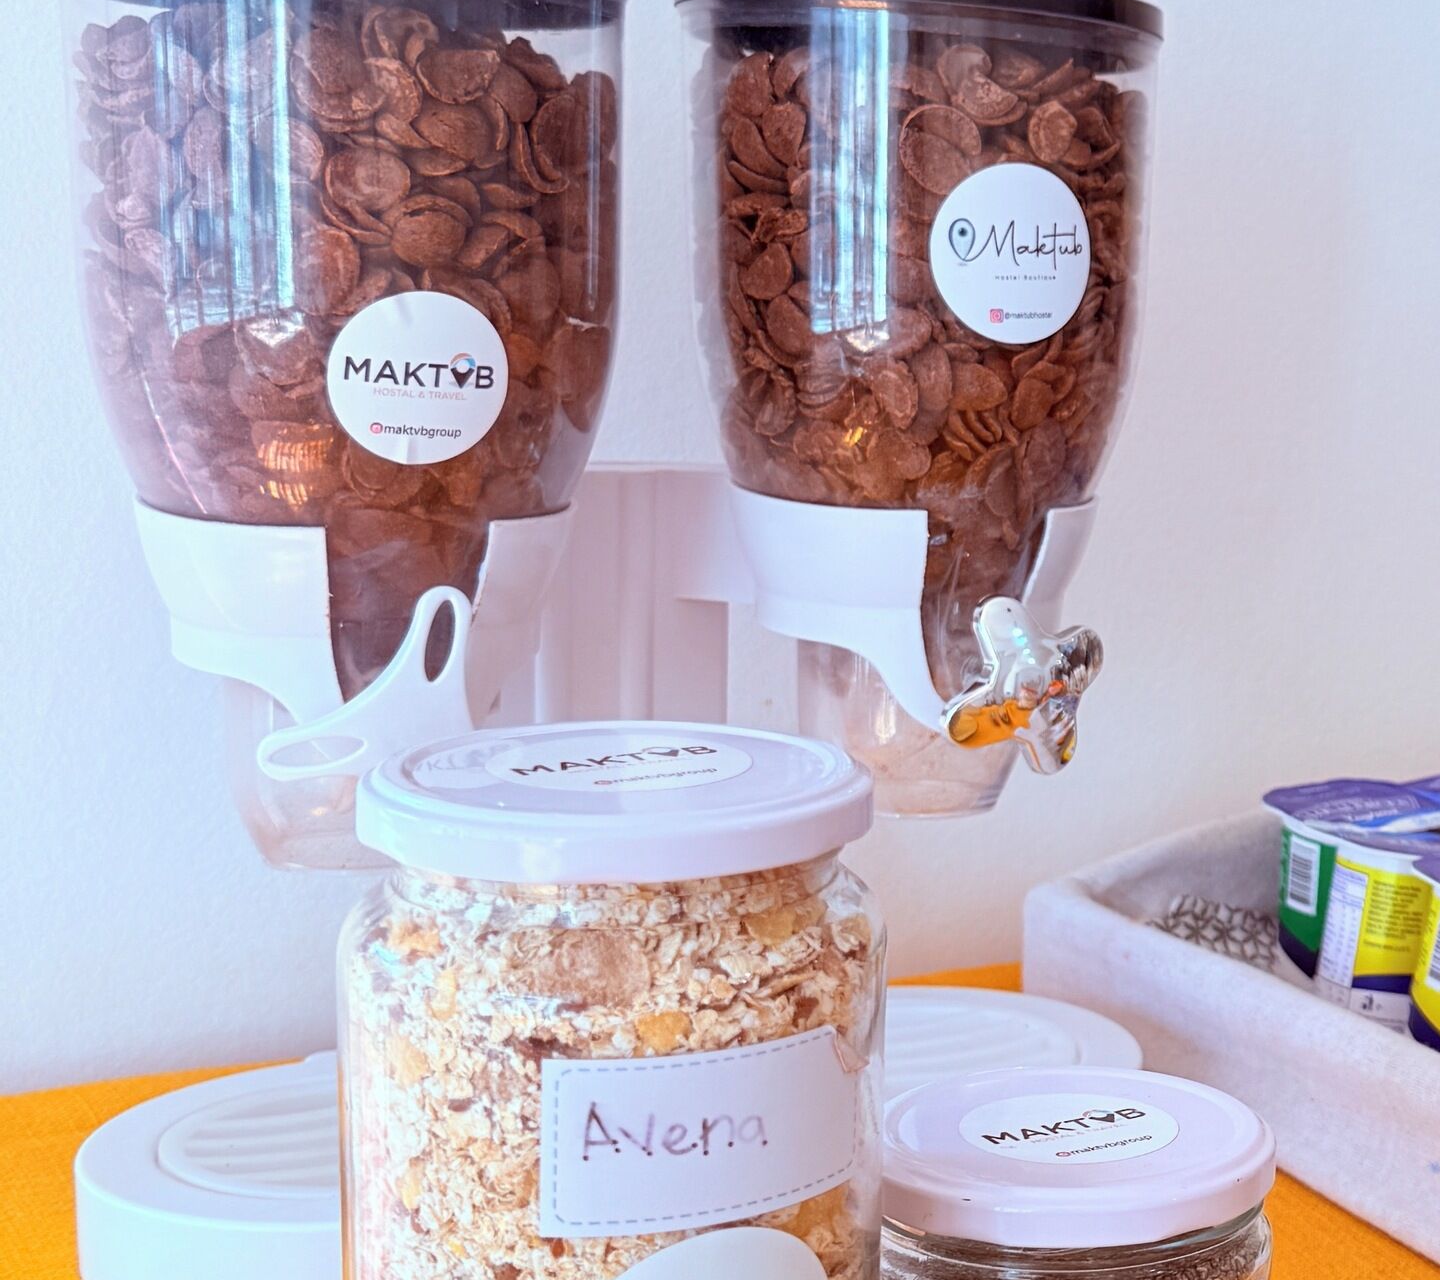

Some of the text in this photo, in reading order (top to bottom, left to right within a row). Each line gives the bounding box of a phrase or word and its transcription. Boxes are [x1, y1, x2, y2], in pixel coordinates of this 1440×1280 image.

[962, 220, 1084, 271] Maktub
[373, 387, 416, 399] HOSTAL
[428, 390, 468, 401] TRAVEL
[581, 1101, 768, 1161] Avena
